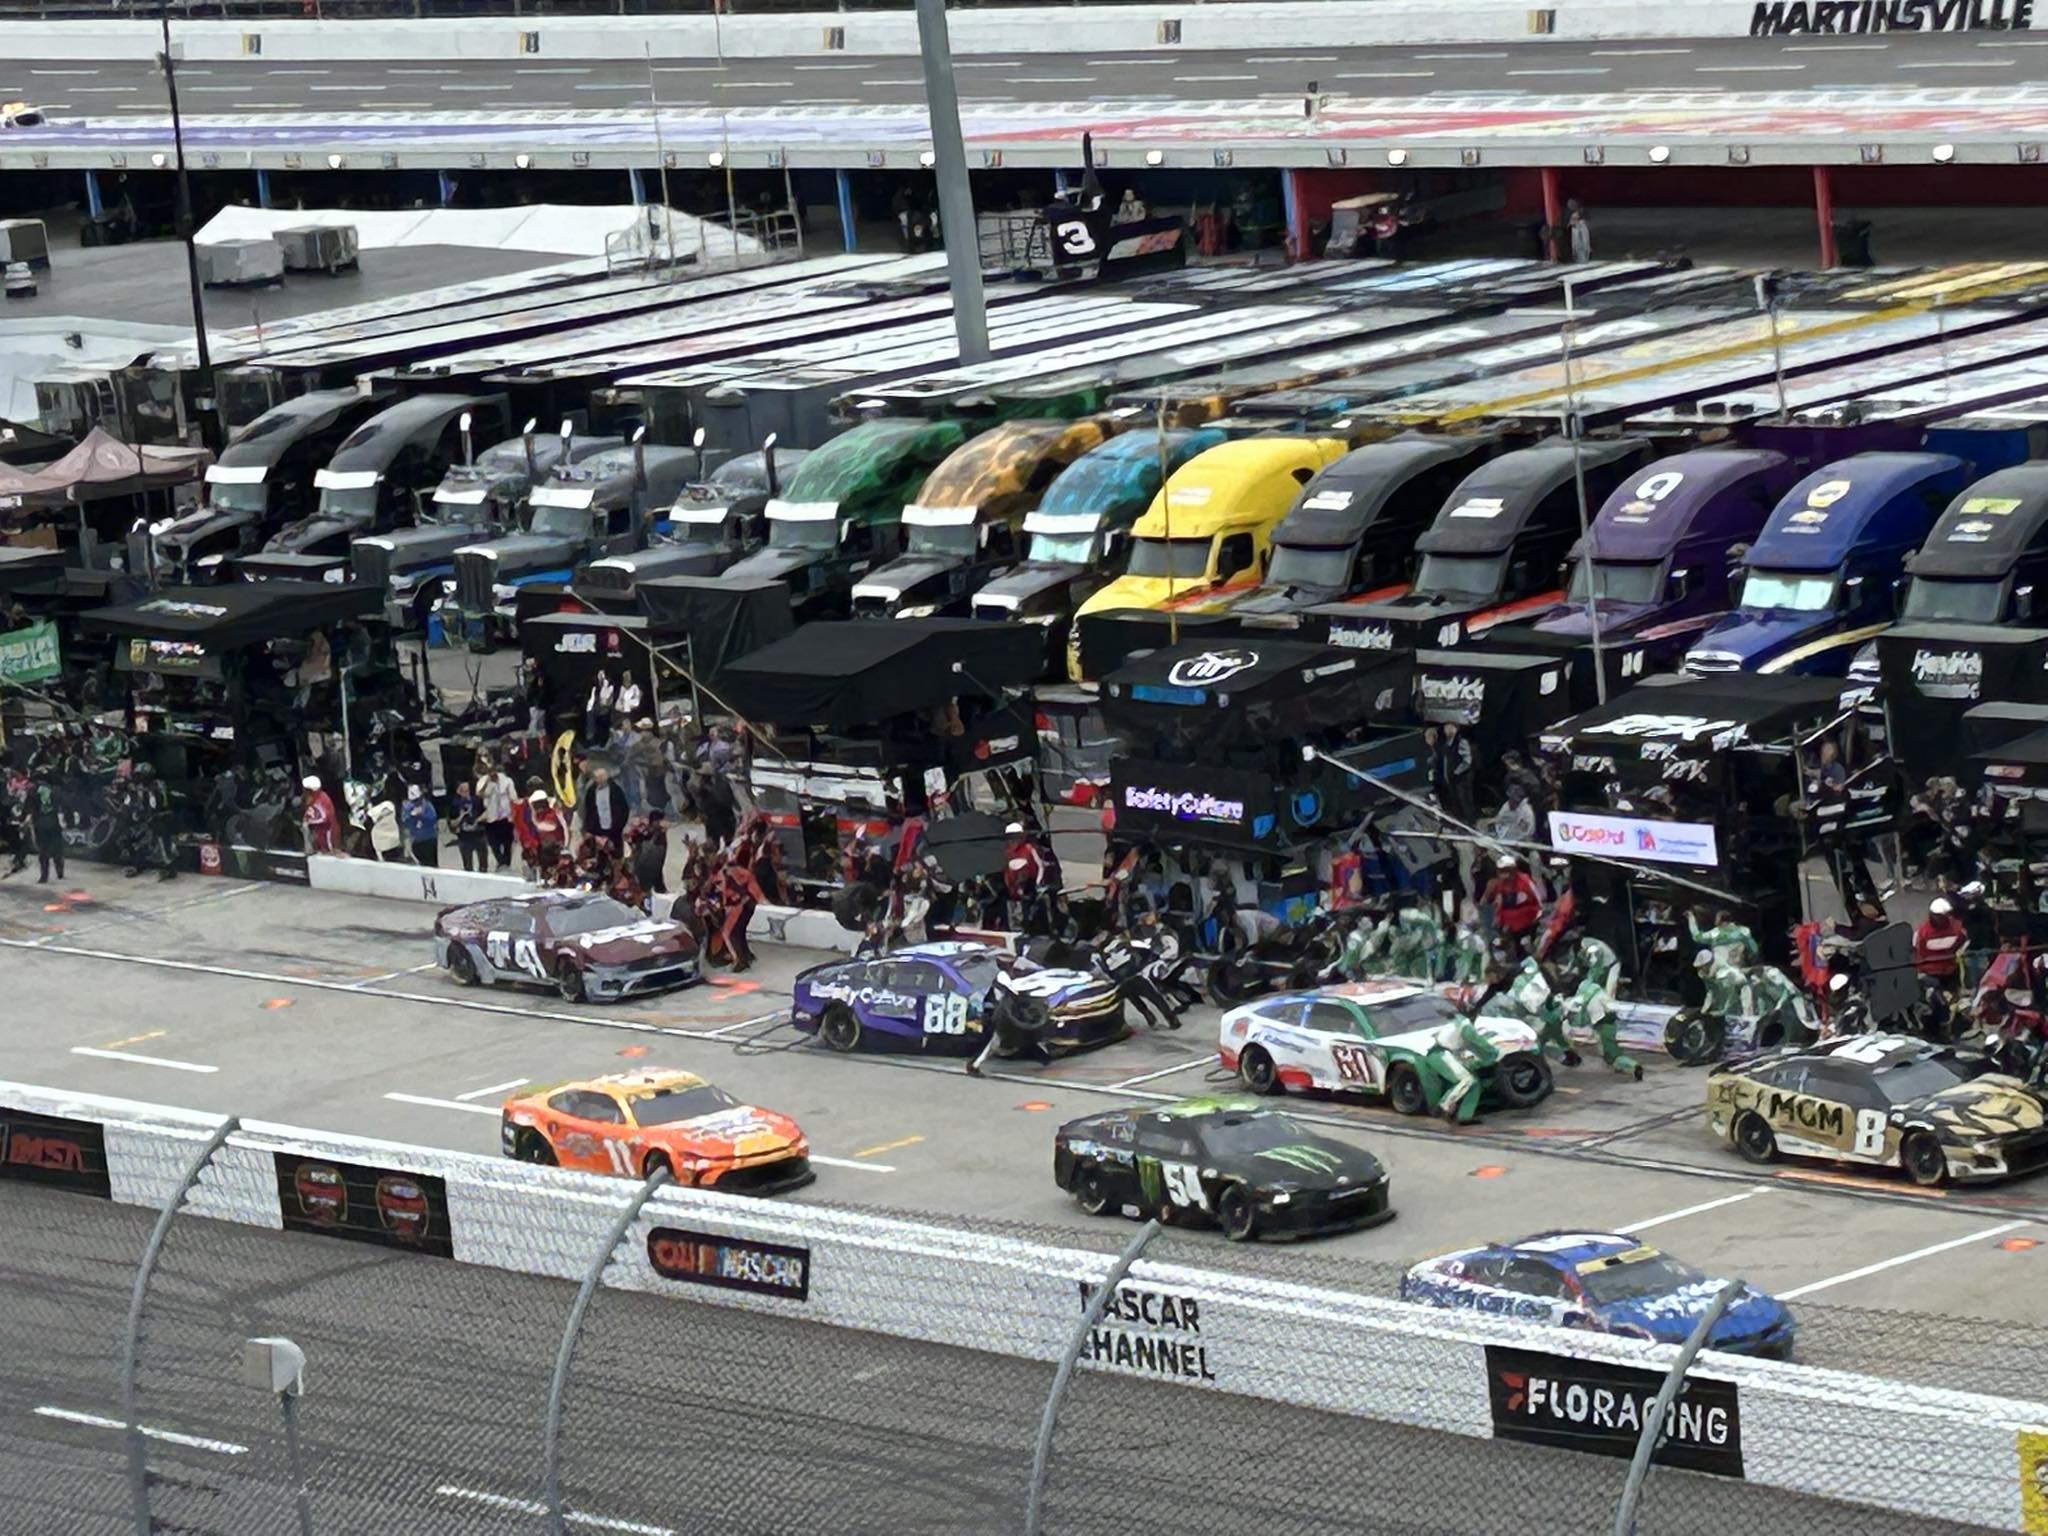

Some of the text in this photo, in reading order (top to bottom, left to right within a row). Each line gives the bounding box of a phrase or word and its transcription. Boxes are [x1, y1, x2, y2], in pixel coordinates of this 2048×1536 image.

[1750, 0, 2033, 36] MARTINSVILLE
[1057, 220, 1096, 255] 3
[923, 993, 968, 1034] 88
[1769, 1092, 1843, 1136] MGM
[1855, 1108, 1888, 1156] 8
[602, 1137, 637, 1177] 11
[1078, 1328, 1216, 1381] HANNEL
